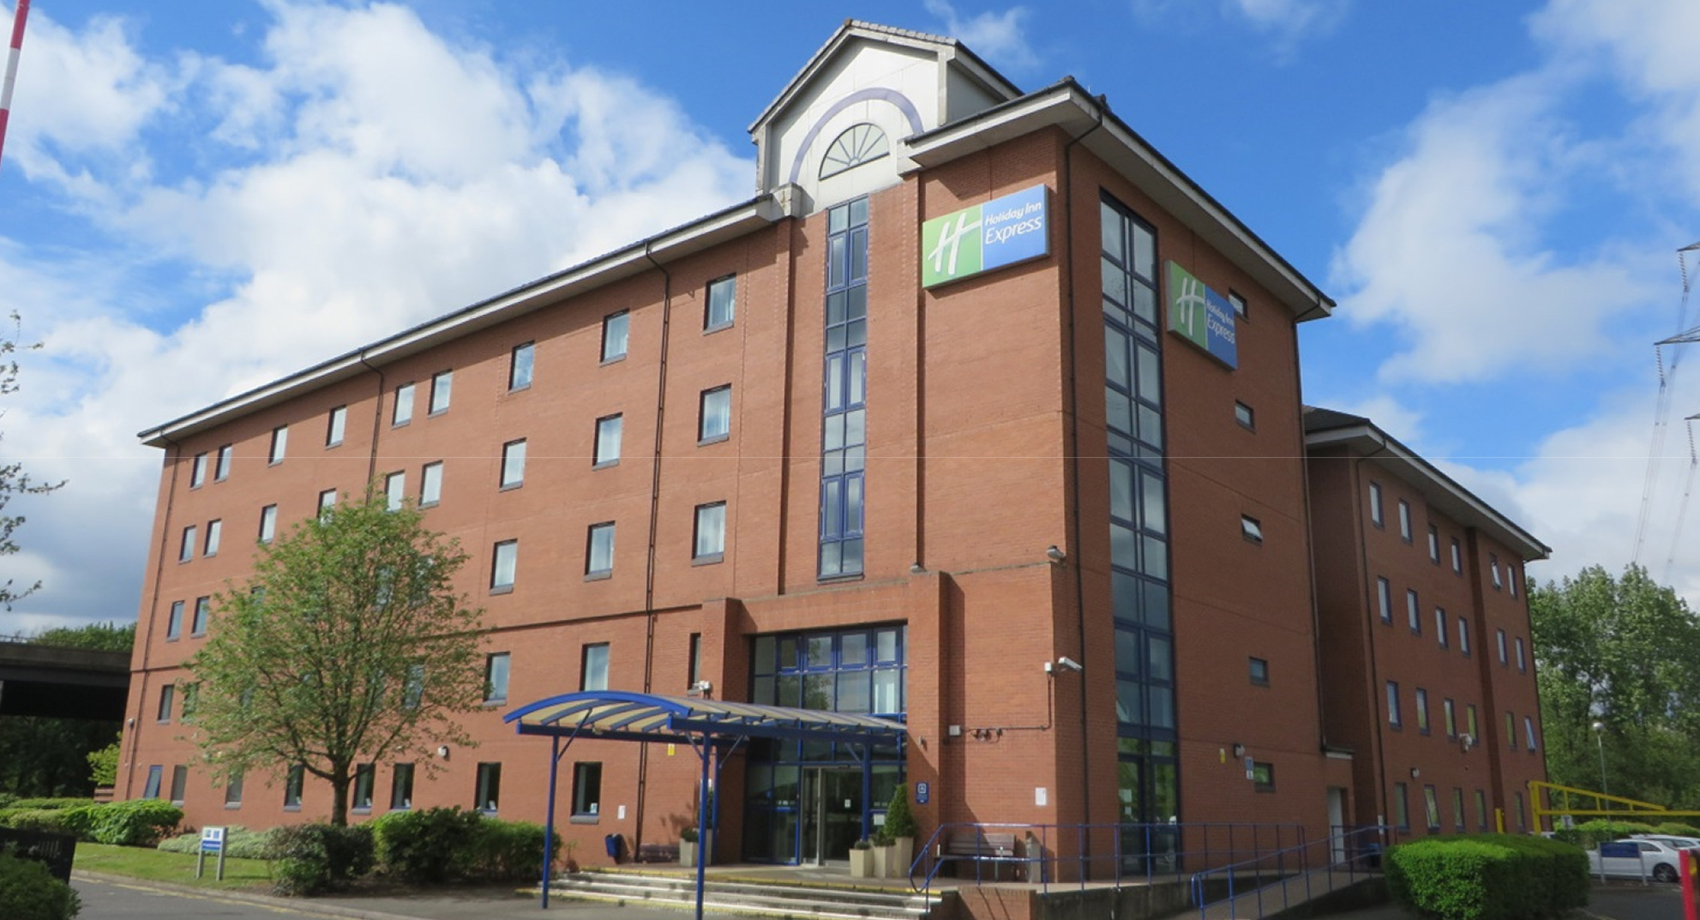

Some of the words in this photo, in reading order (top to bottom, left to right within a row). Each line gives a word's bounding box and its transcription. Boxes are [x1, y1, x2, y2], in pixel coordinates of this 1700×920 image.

[985, 207, 1024, 226] Holiday
[1025, 202, 1042, 214] Inn
[985, 215, 1042, 244] Express
[1207, 313, 1235, 344] Express
